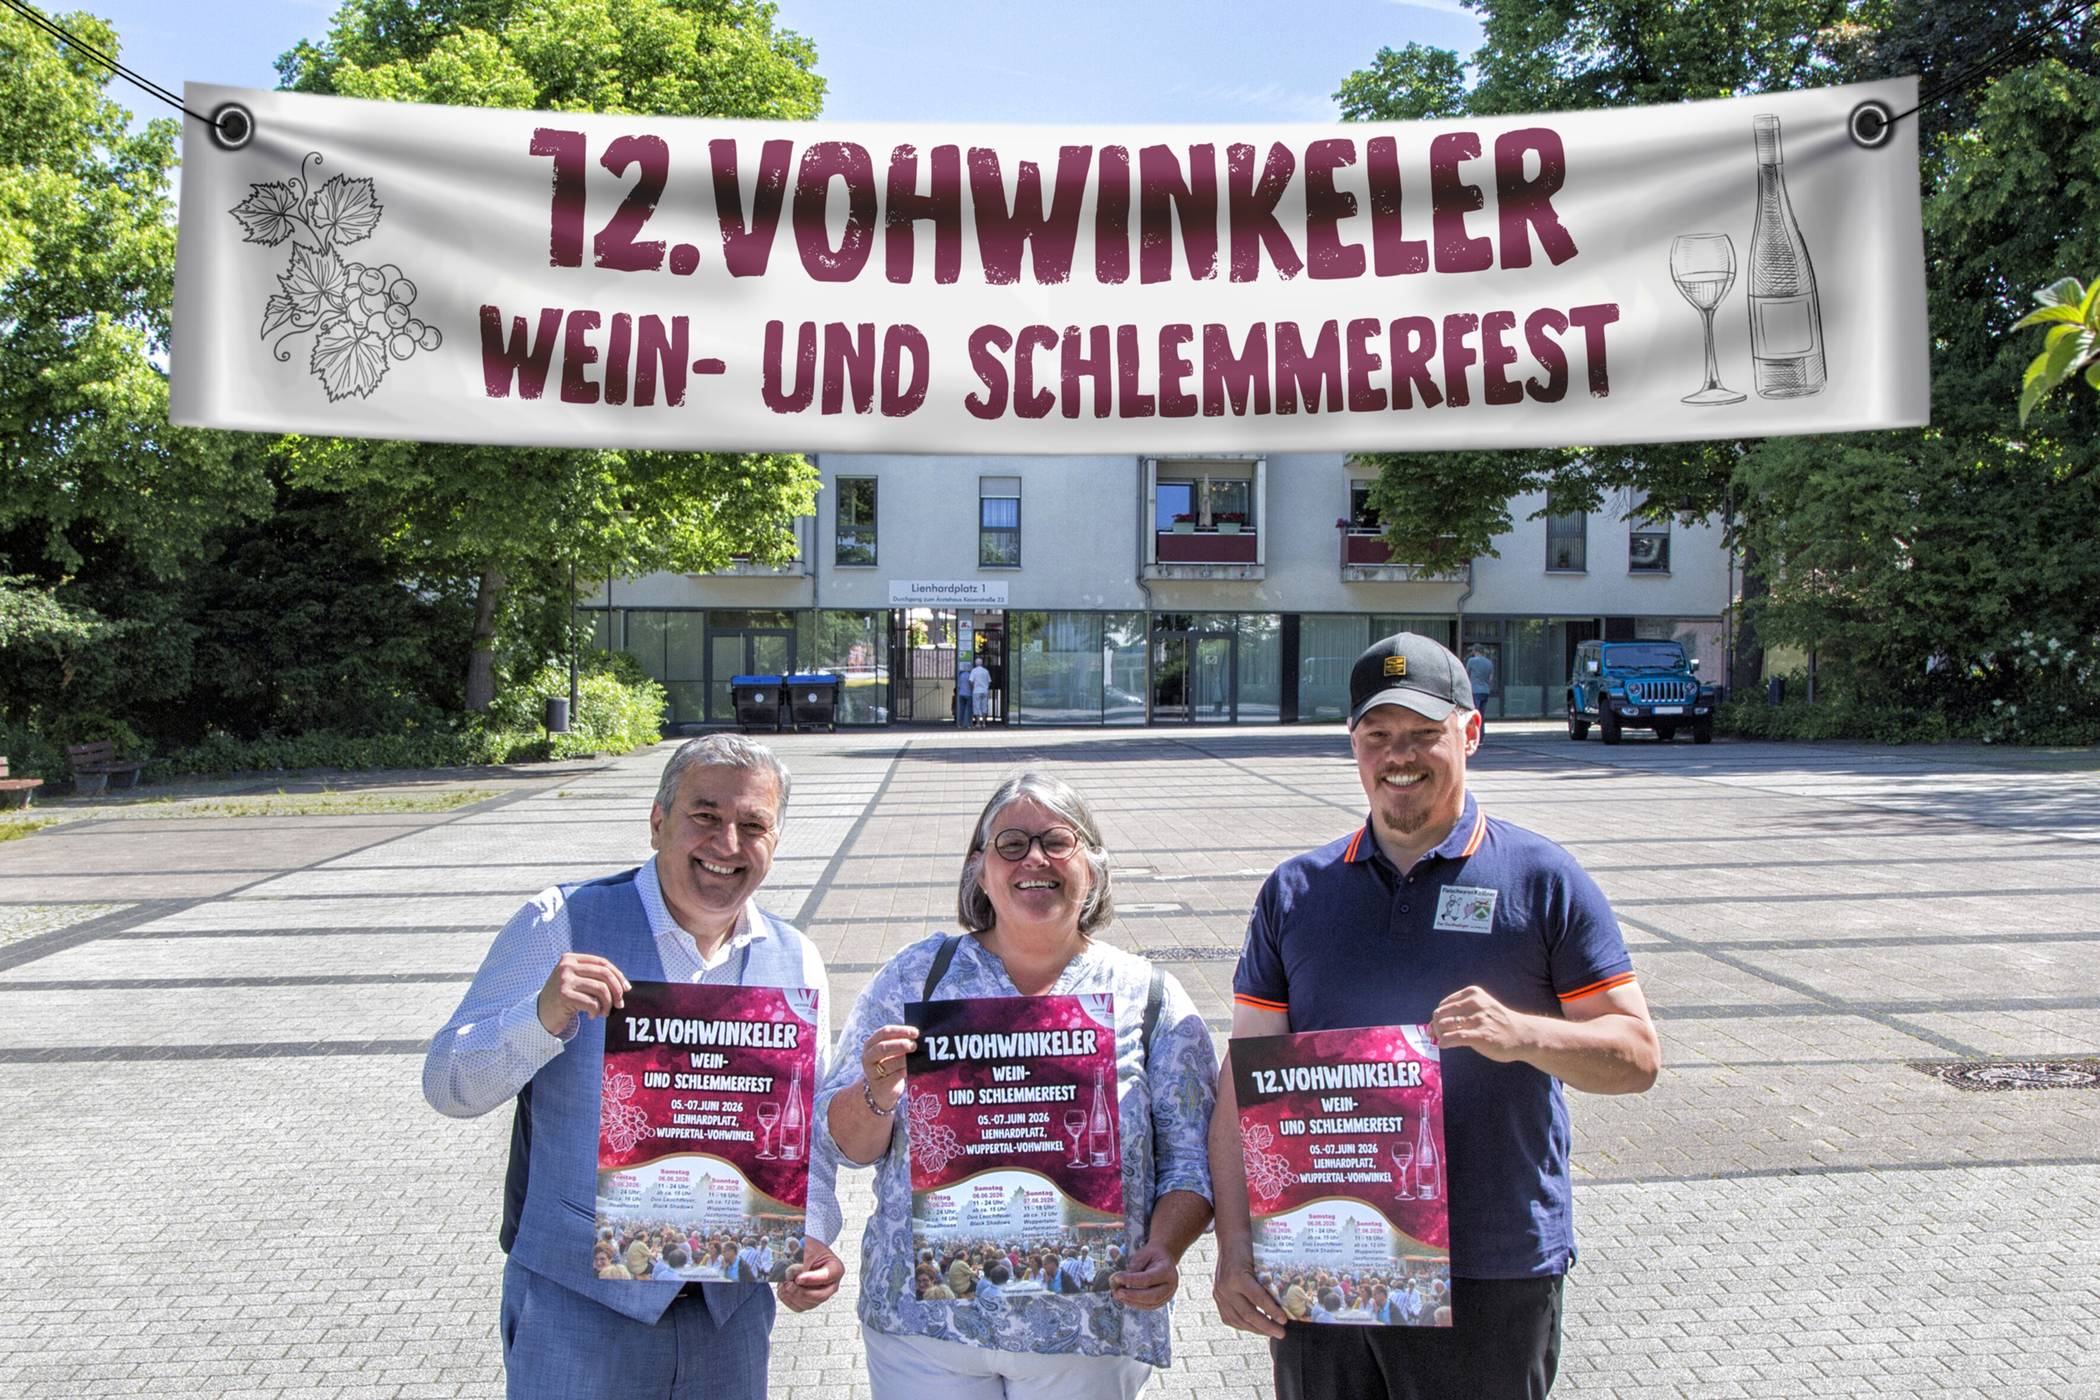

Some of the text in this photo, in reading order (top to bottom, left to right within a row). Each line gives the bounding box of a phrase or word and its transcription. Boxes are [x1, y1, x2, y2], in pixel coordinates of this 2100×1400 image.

[479, 303, 1620, 420] WEIN- UND SCHLEMMERFEST
[911, 583, 986, 595] Lienhardplatz 1
[690, 1053, 728, 1068] WEIN-
[992, 1066, 1030, 1082] WEIN-
[644, 1072, 773, 1092] UND SCHLEMMERFEST
[948, 1085, 1076, 1105] UND SCHLEMMERFEST
[722, 1101, 744, 1112] 2026
[1321, 1097, 1358, 1112] WEIN-
[673, 1114, 740, 1128] LIENHARDPLATZ,
[1028, 1112, 1050, 1123] 2026
[981, 1127, 1048, 1140] LIENHARDPLATZ,
[1280, 1117, 1403, 1136] UND SCHLEMMERFEST
[656, 1128, 755, 1141] WUPPERTAL-VOHWINKEL
[966, 1141, 1064, 1155] WUPPERTAL-VOHWINKEL
[1358, 1144, 1378, 1154] 2026
[1314, 1158, 1376, 1169] LIENHARDPLATZ,
[1300, 1172, 1392, 1184] WUPPERTAL-VOHWINKEL
